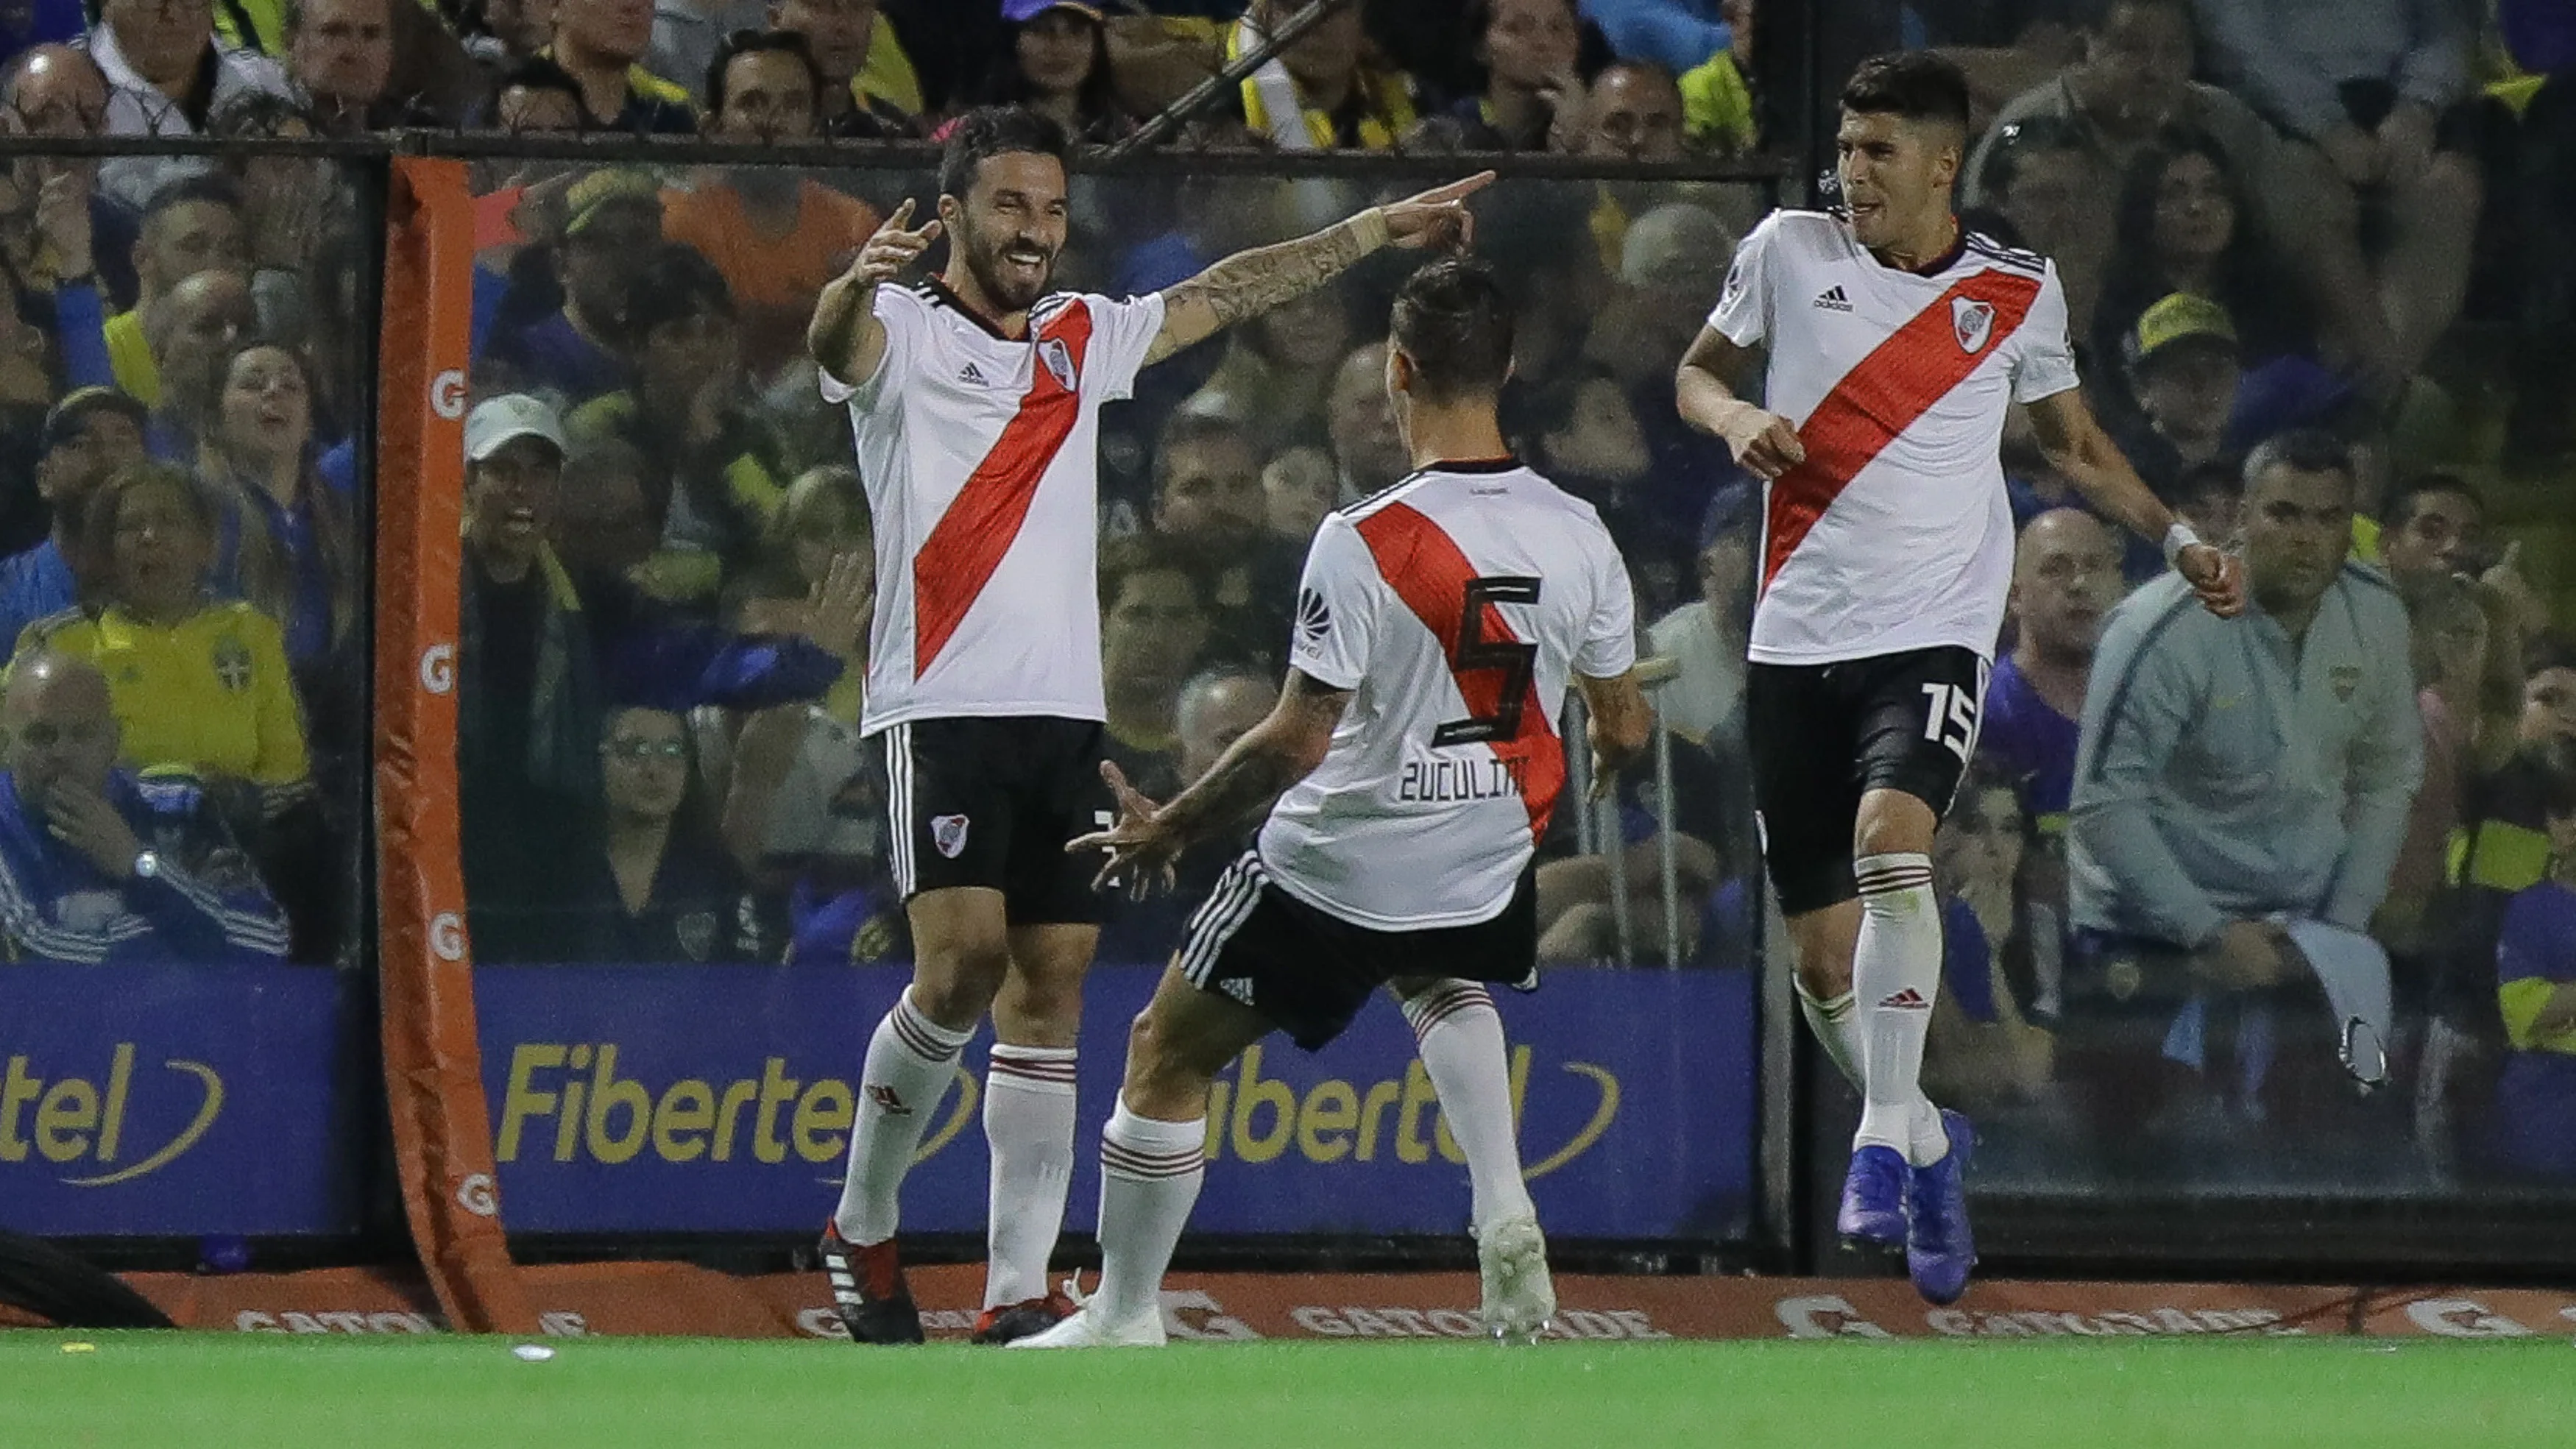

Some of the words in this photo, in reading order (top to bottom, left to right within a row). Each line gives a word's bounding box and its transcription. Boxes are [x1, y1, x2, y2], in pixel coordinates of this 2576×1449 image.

[430, 369, 465, 418] G
[421, 642, 452, 694] G
[1432, 575, 1542, 748] 5
[1922, 681, 1975, 764] 15
[430, 910, 465, 960] G
[498, 1044, 854, 1163] Fiberte
[1203, 1044, 1532, 1163] ibertl
[456, 1172, 498, 1216] G
[1290, 1305, 1672, 1336] GATODE
